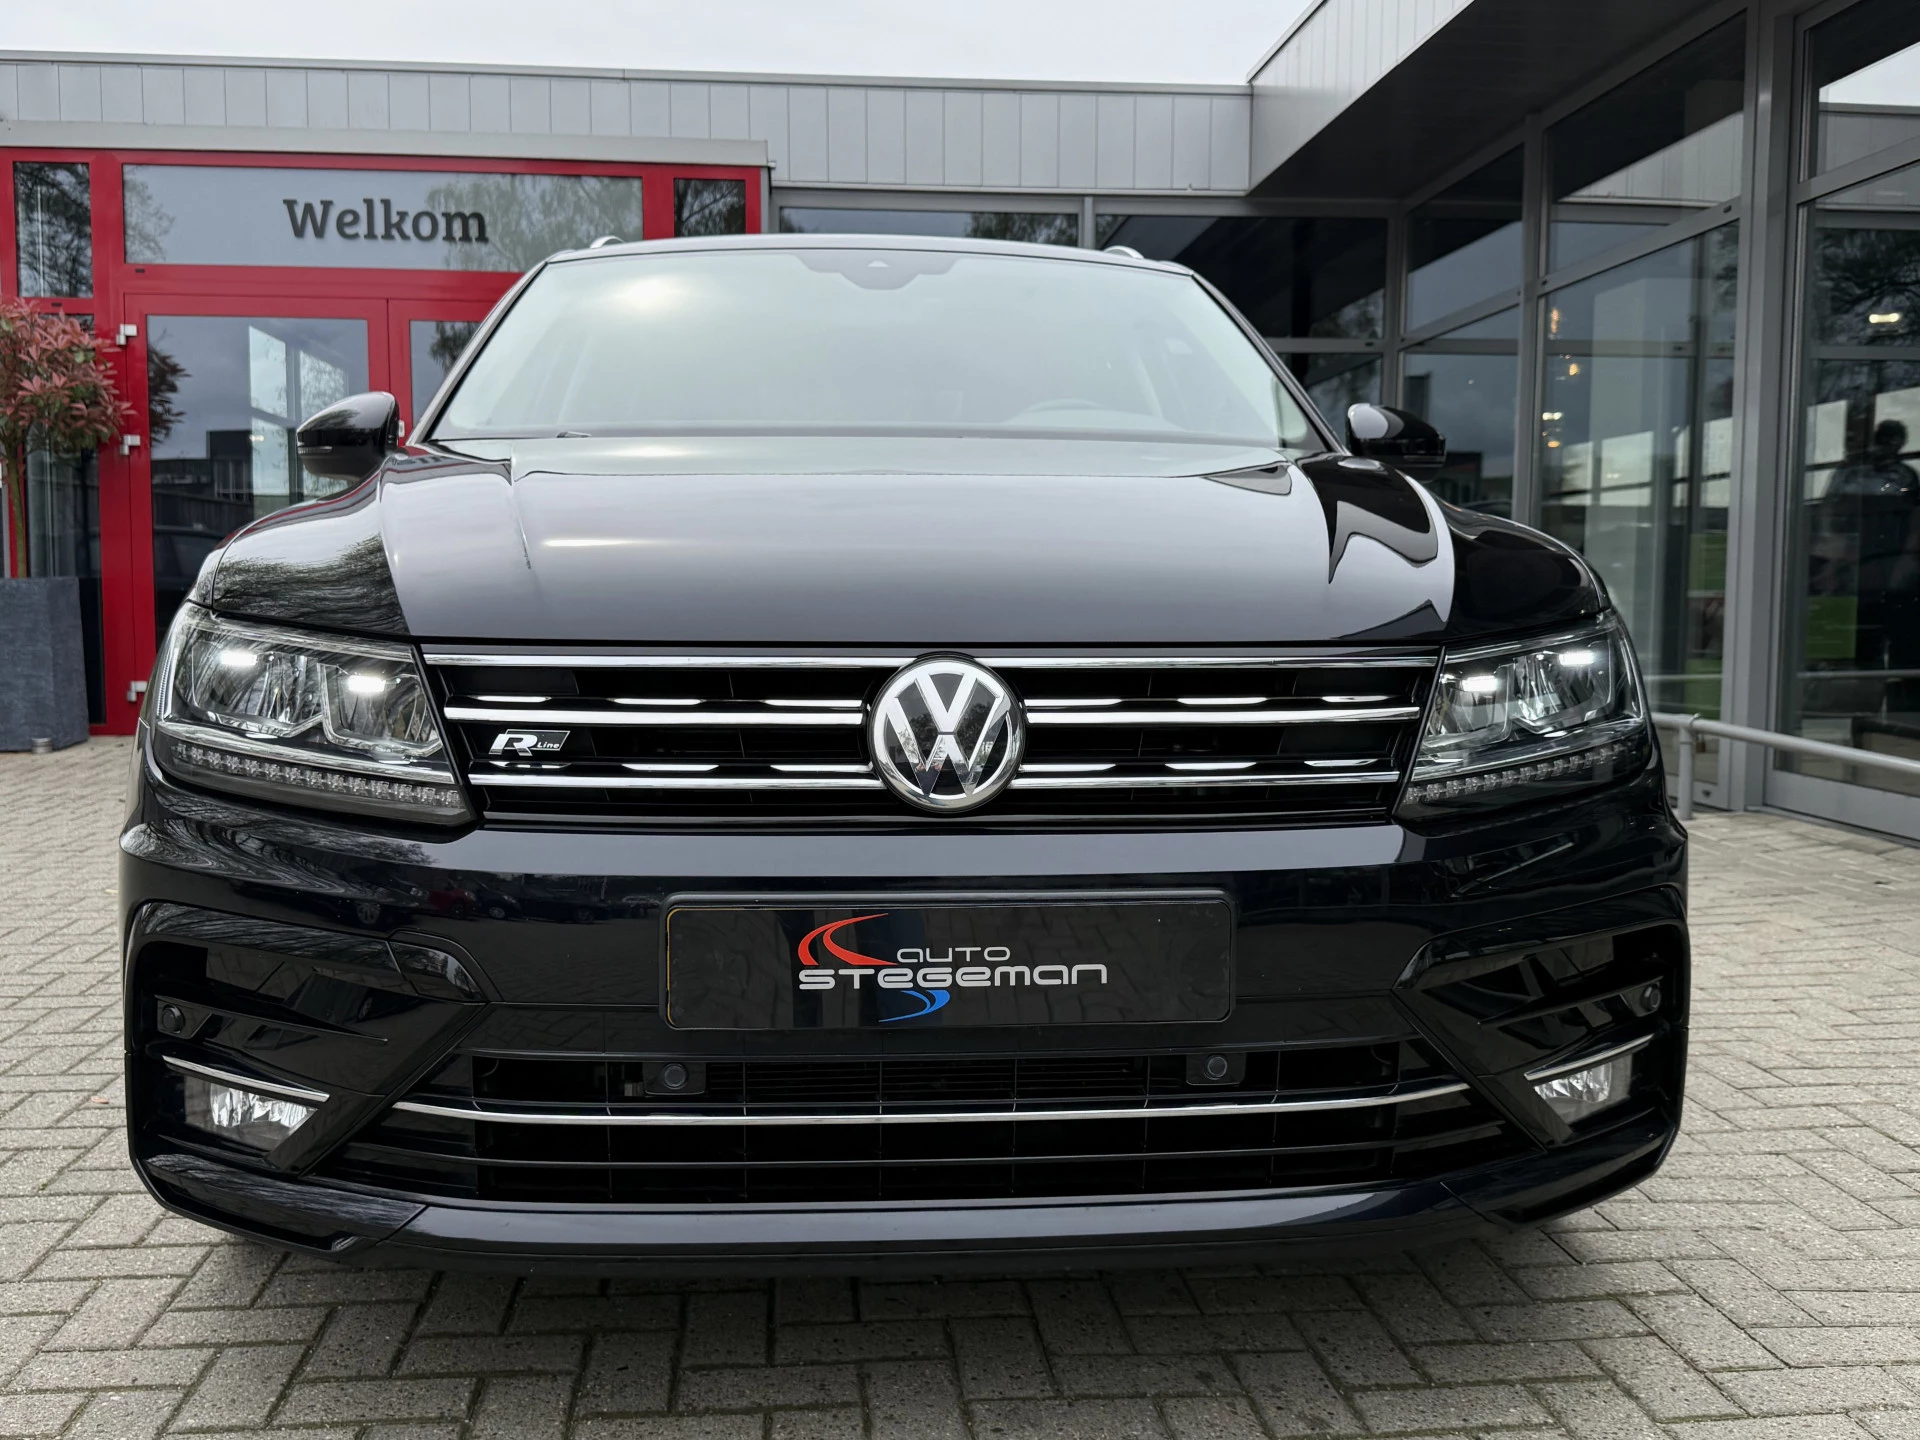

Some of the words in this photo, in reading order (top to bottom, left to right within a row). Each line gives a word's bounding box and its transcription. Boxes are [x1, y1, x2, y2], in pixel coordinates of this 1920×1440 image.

[282, 198, 490, 244] Welkom
[488, 733, 538, 757] R
[536, 741, 561, 749] Line
[885, 666, 1011, 798] VW
